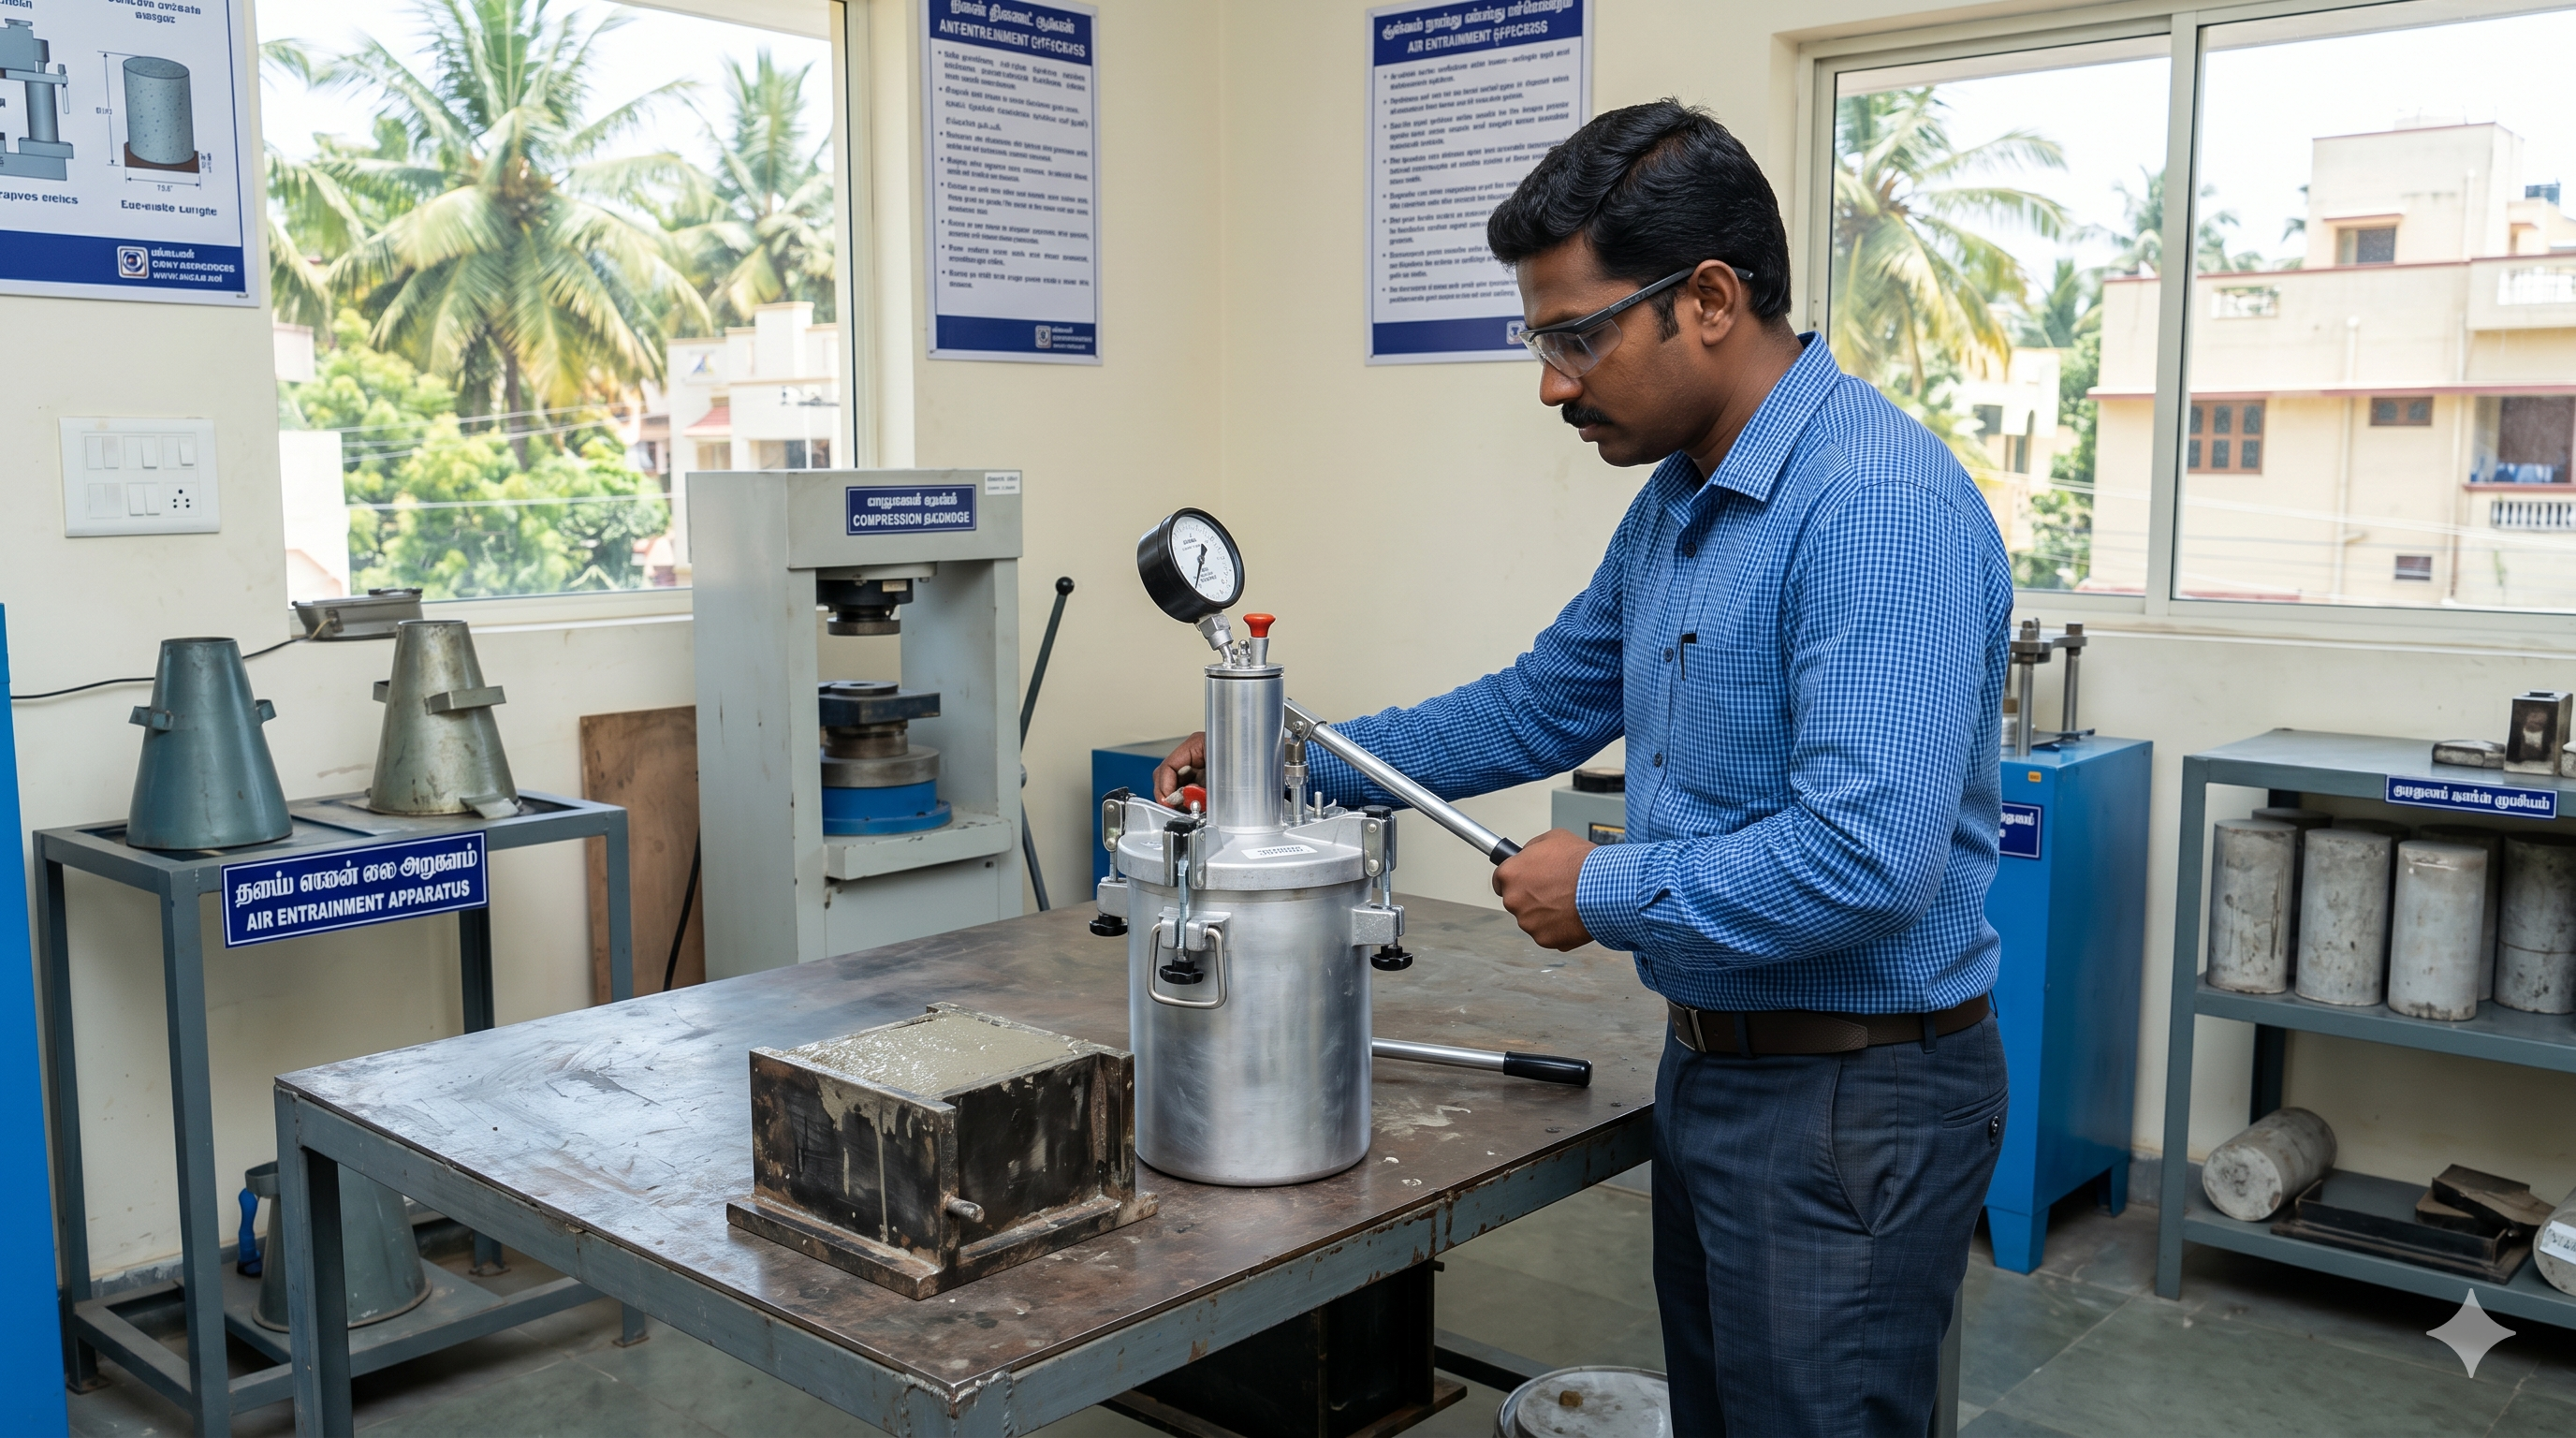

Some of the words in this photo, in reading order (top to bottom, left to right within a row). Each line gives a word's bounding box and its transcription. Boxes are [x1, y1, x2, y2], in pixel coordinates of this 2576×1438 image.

[1407, 37, 1425, 53] AIR
[1426, 28, 1492, 51] ENTRAINMENT
[853, 512, 922, 527] COMPRESSION
[246, 910, 274, 932] AIR
[277, 893, 386, 927] ENTRAINMENT
[388, 879, 471, 909] APPARATUS
